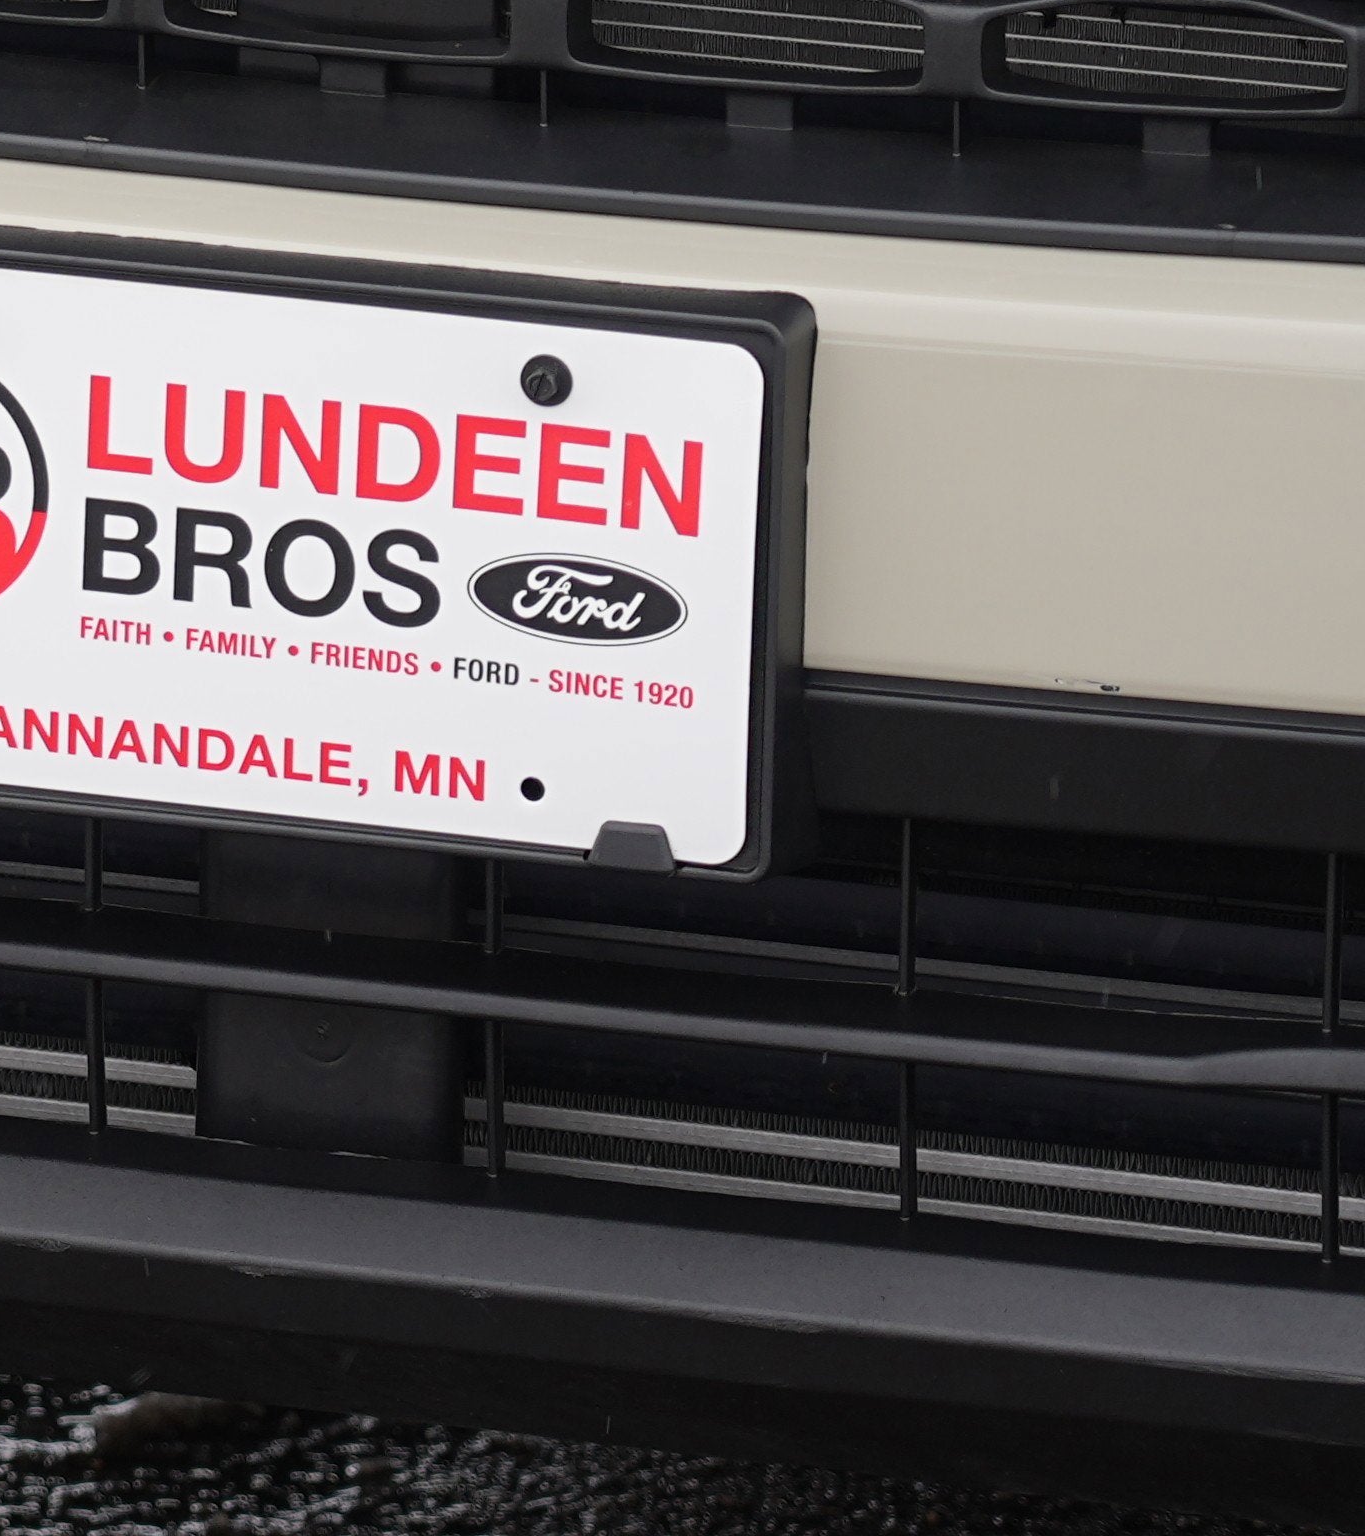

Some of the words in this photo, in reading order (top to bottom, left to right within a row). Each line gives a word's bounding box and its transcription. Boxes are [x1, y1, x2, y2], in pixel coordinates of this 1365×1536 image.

[86, 374, 703, 538] LUNDEEN
[82, 497, 441, 628] BROS
[511, 564, 646, 632] Ford
[80, 616, 152, 646] FAITH
[185, 628, 277, 659] FAMILY
[309, 642, 420, 676] FRIENDS
[453, 657, 521, 686] FORD
[548, 669, 624, 700] SINCE
[633, 680, 695, 710] 1920
[394, 750, 487, 802] MN
